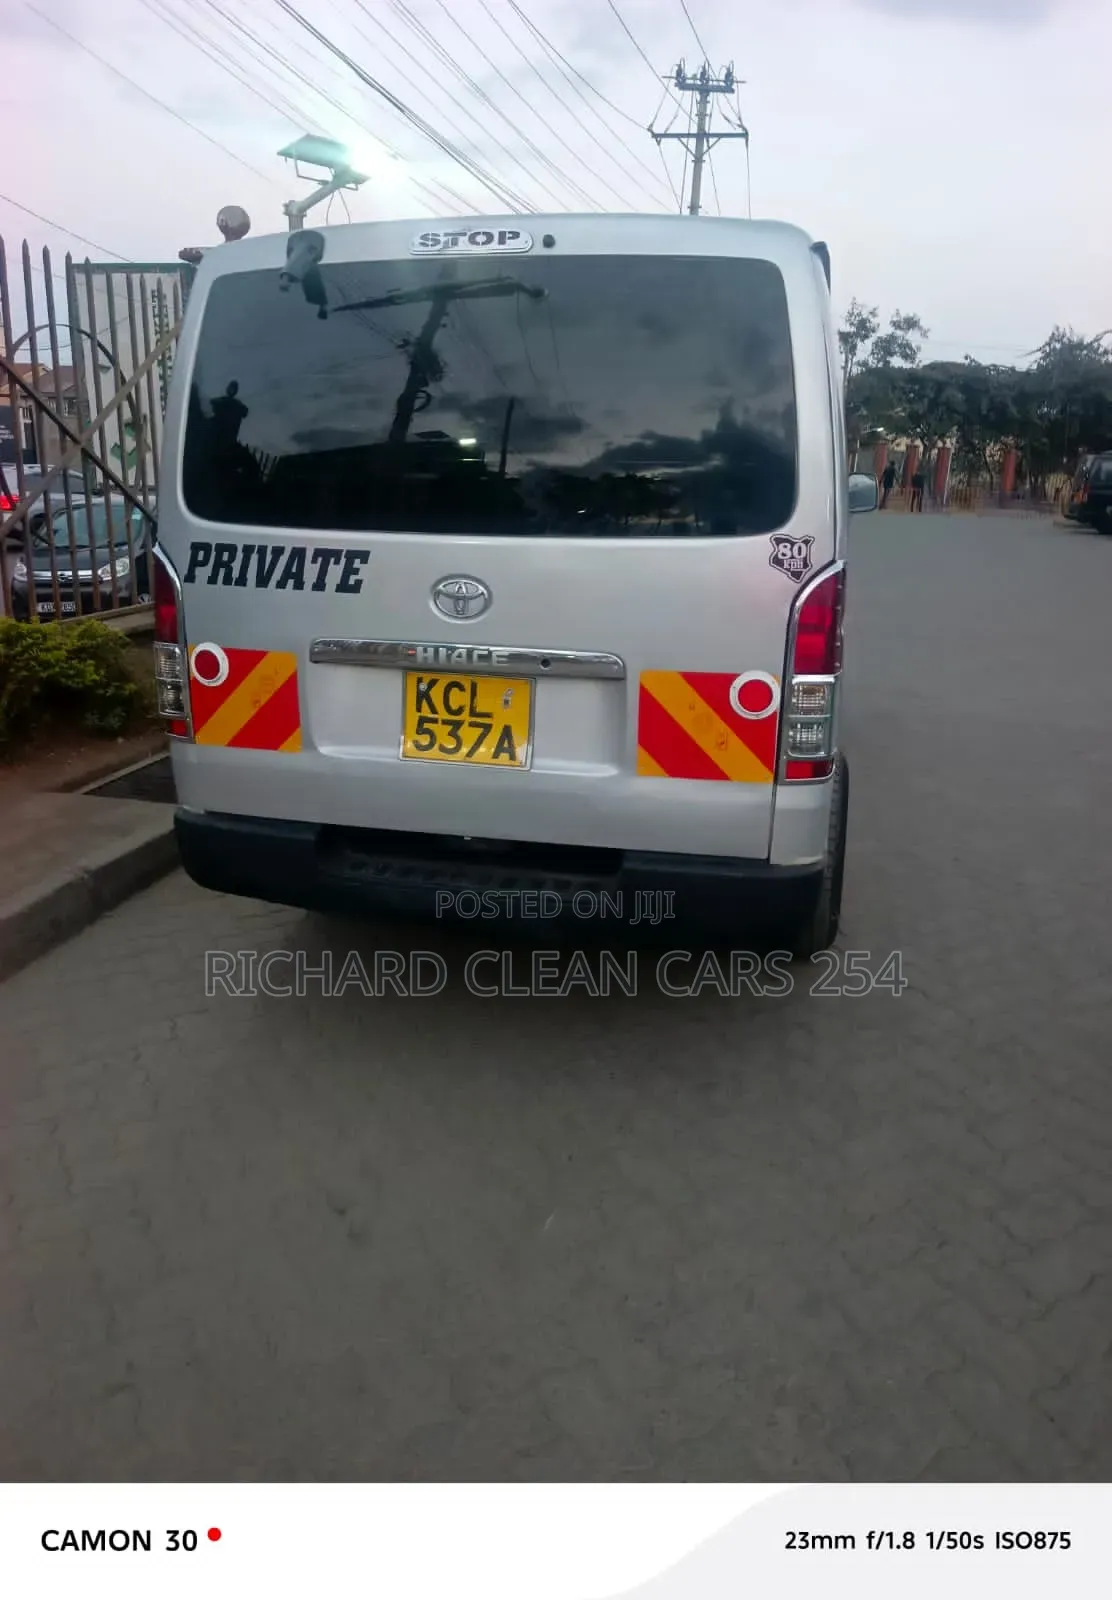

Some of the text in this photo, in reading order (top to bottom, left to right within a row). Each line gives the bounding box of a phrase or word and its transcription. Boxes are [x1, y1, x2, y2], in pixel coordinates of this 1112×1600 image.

[419, 230, 521, 248] STOP
[778, 542, 807, 560] 80
[184, 541, 371, 594] PRIVATE
[416, 646, 510, 667] HIACE
[415, 676, 494, 719] KCL
[412, 715, 517, 761] 537A
